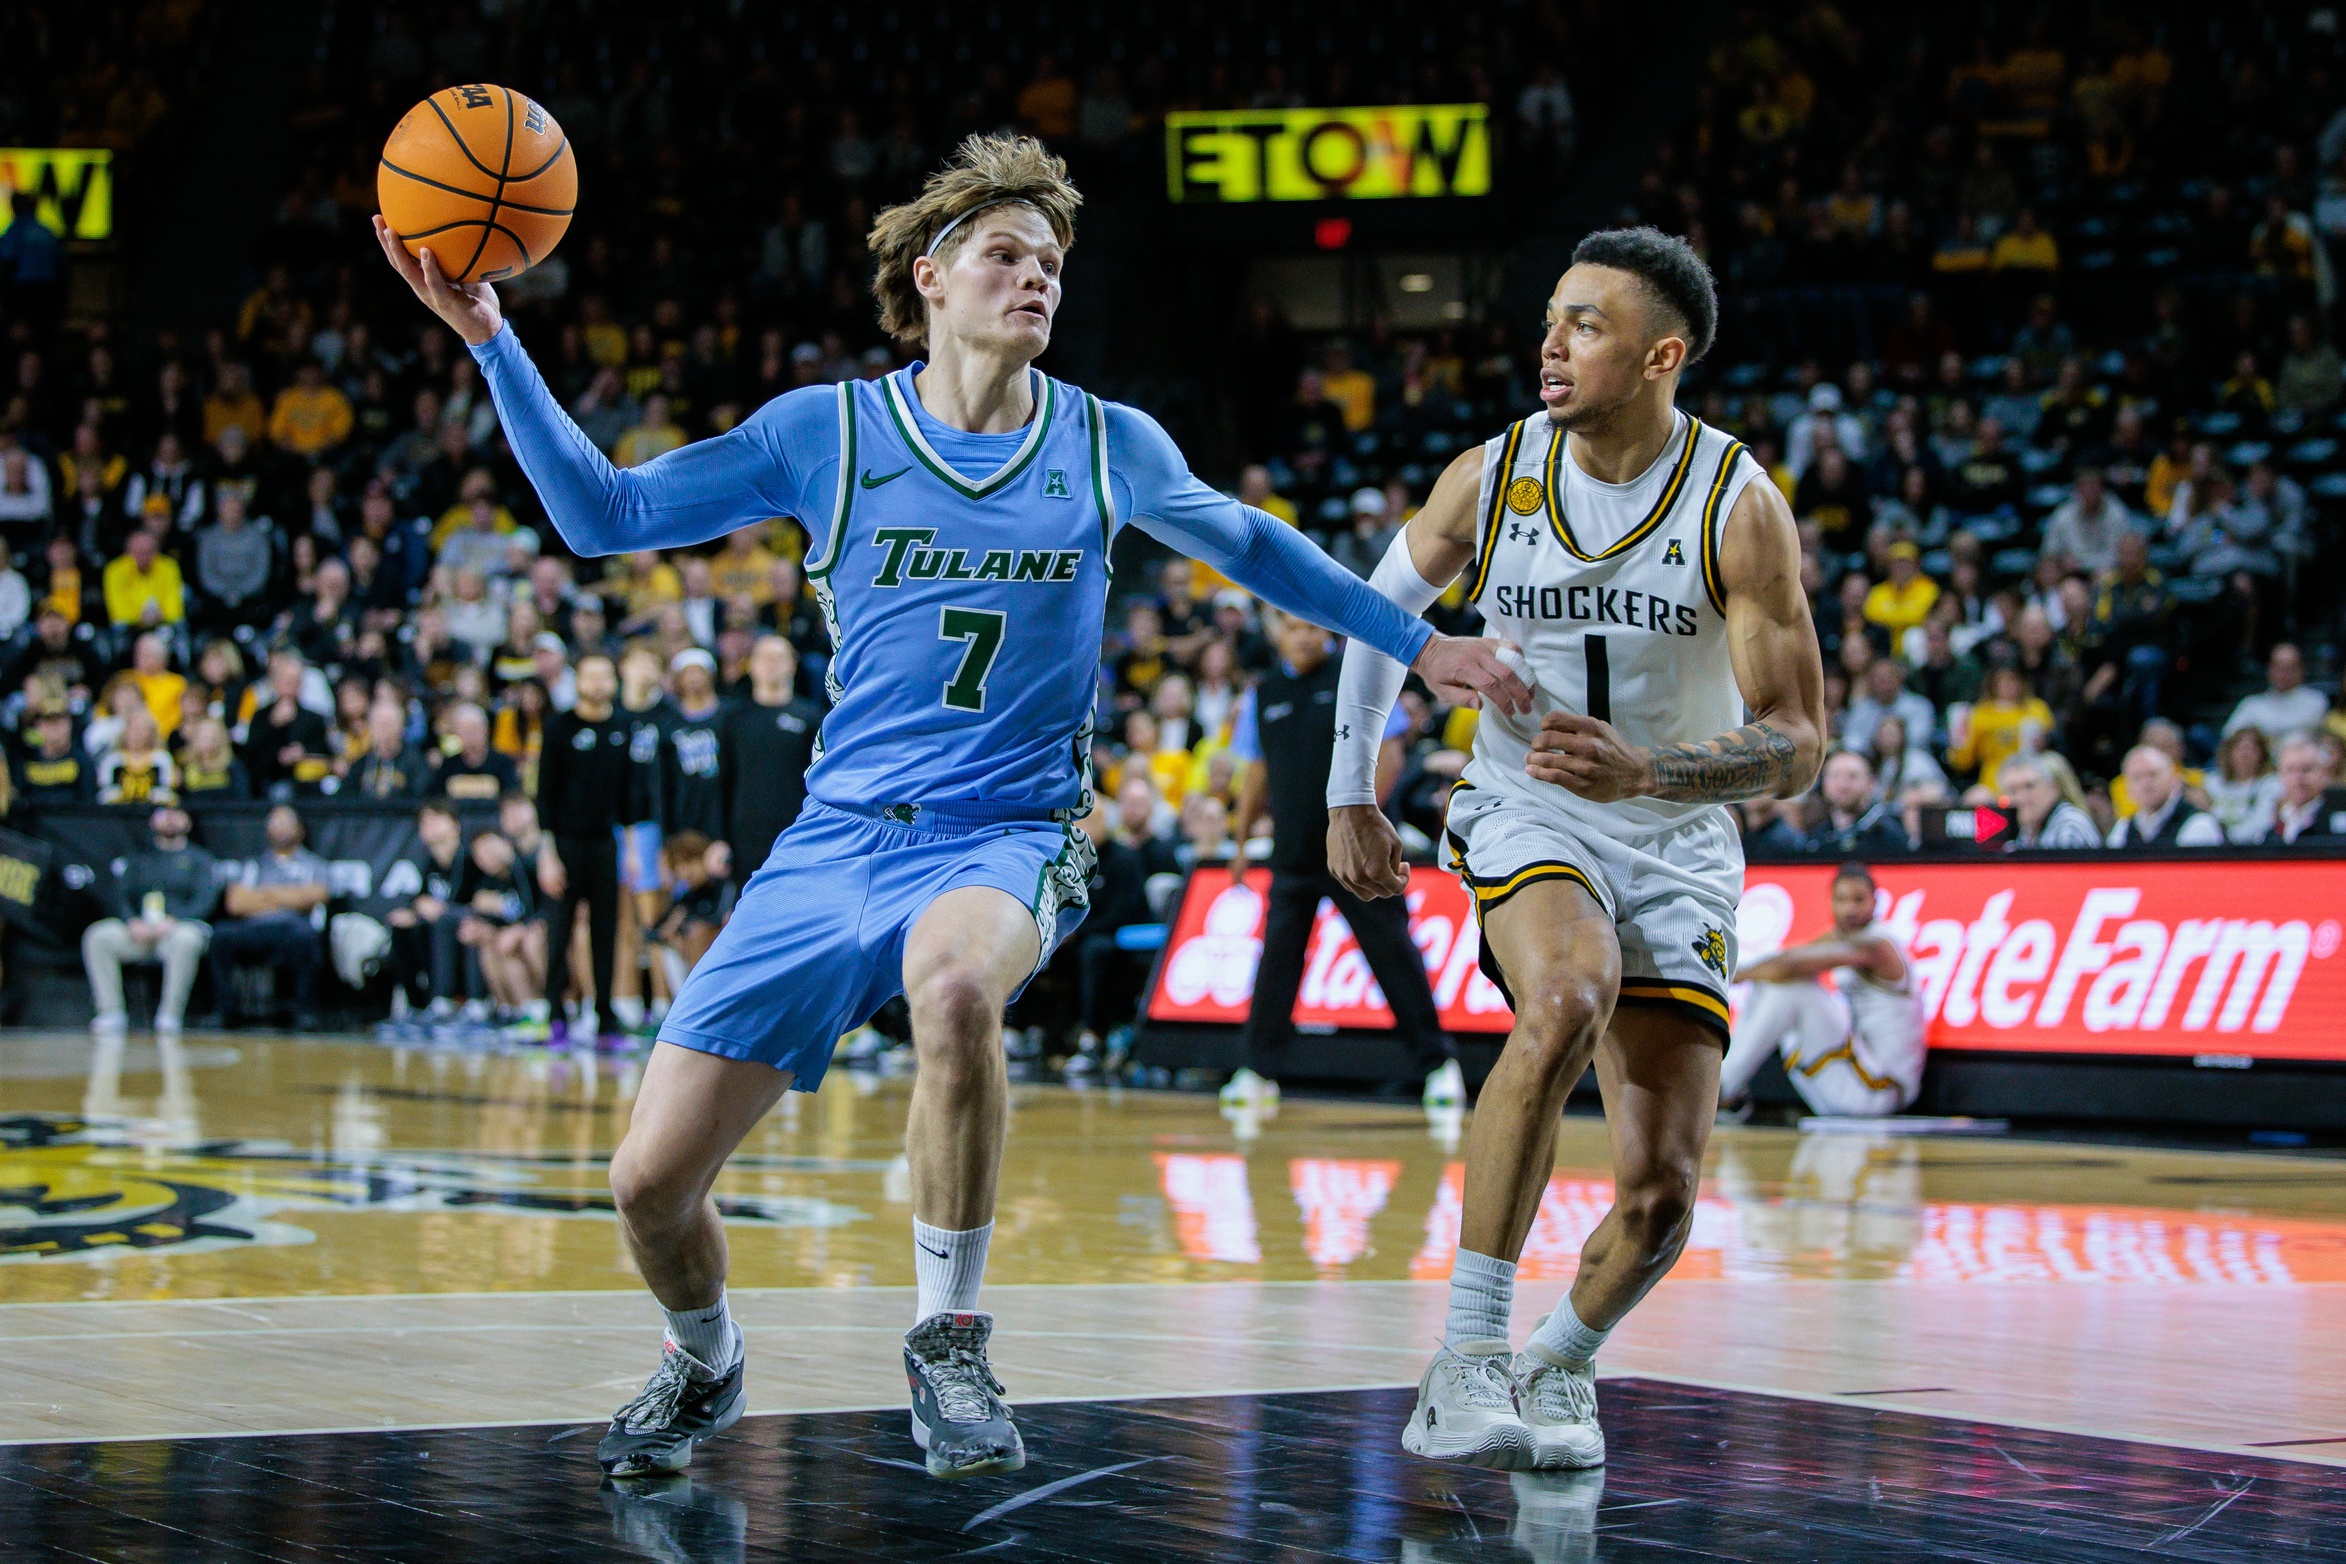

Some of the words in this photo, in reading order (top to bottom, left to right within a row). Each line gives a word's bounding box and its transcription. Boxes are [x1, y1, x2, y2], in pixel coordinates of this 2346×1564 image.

[871, 527, 1084, 588] TULANE
[1497, 585, 1697, 636] SHOCKERS
[938, 605, 1007, 713] 7
[1584, 634, 1611, 726] 1
